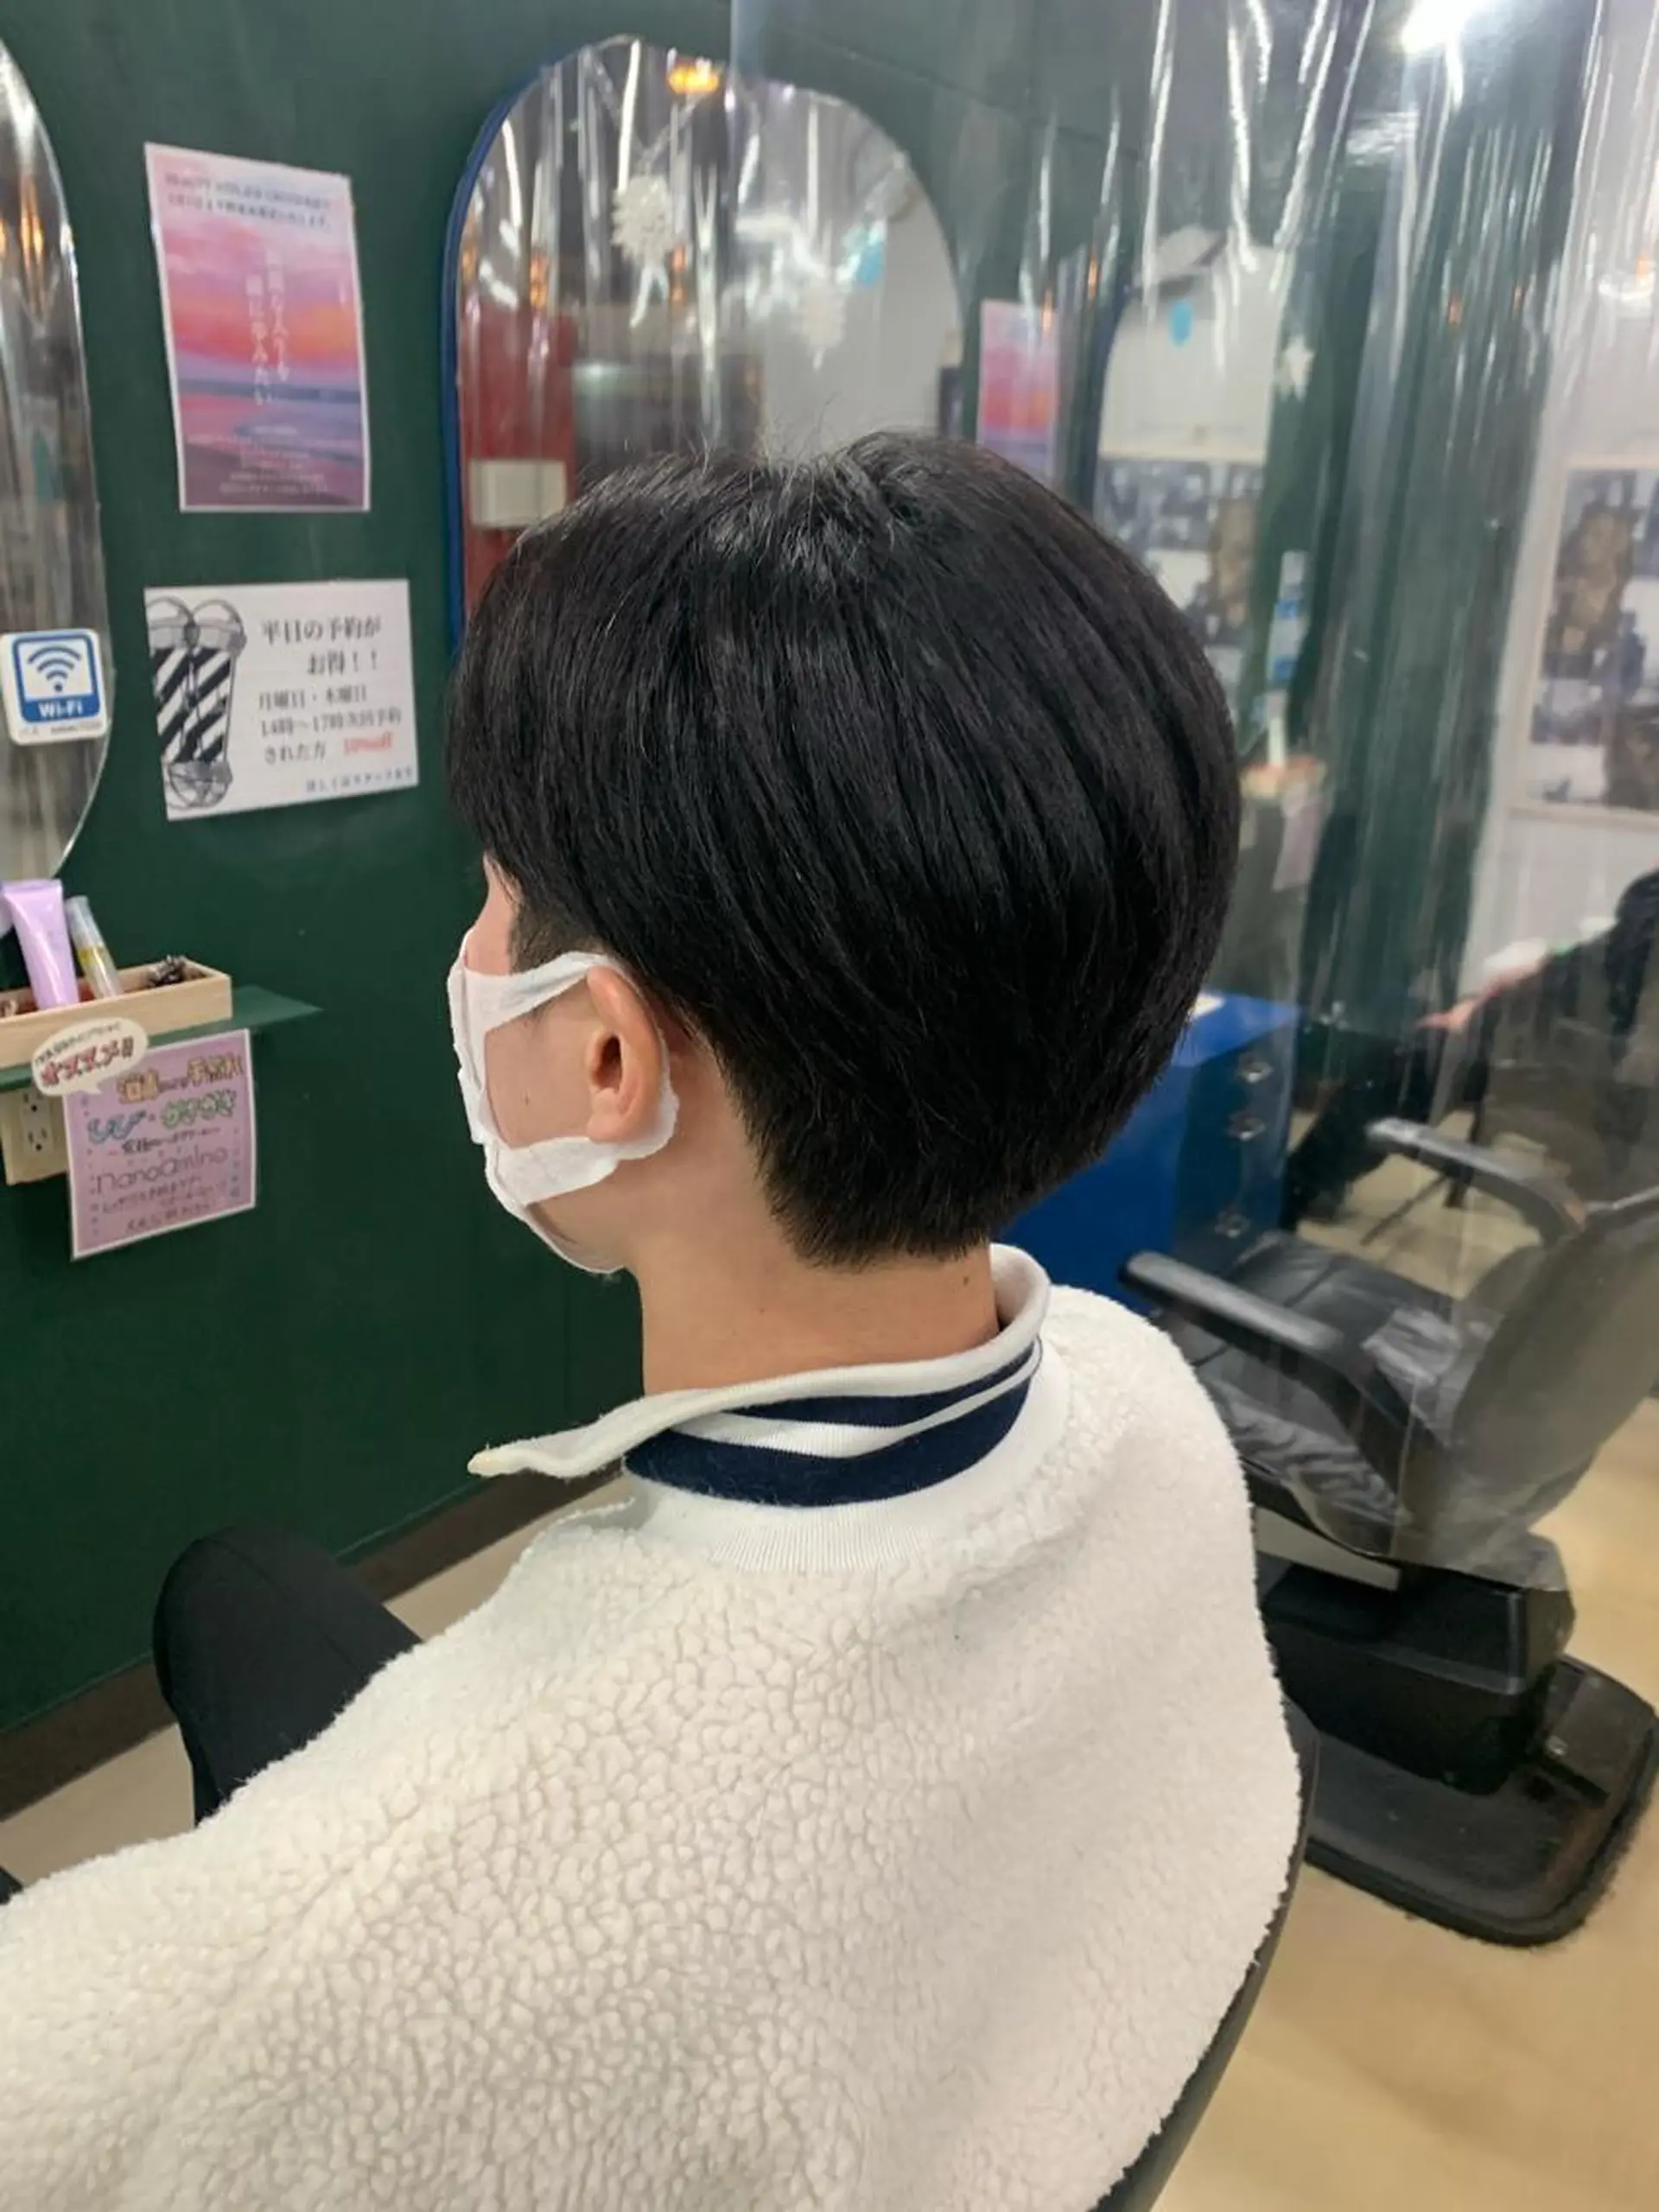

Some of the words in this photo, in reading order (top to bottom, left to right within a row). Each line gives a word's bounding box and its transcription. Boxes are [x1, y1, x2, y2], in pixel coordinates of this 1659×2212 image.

[262, 616, 382, 645] 平日の予約が
